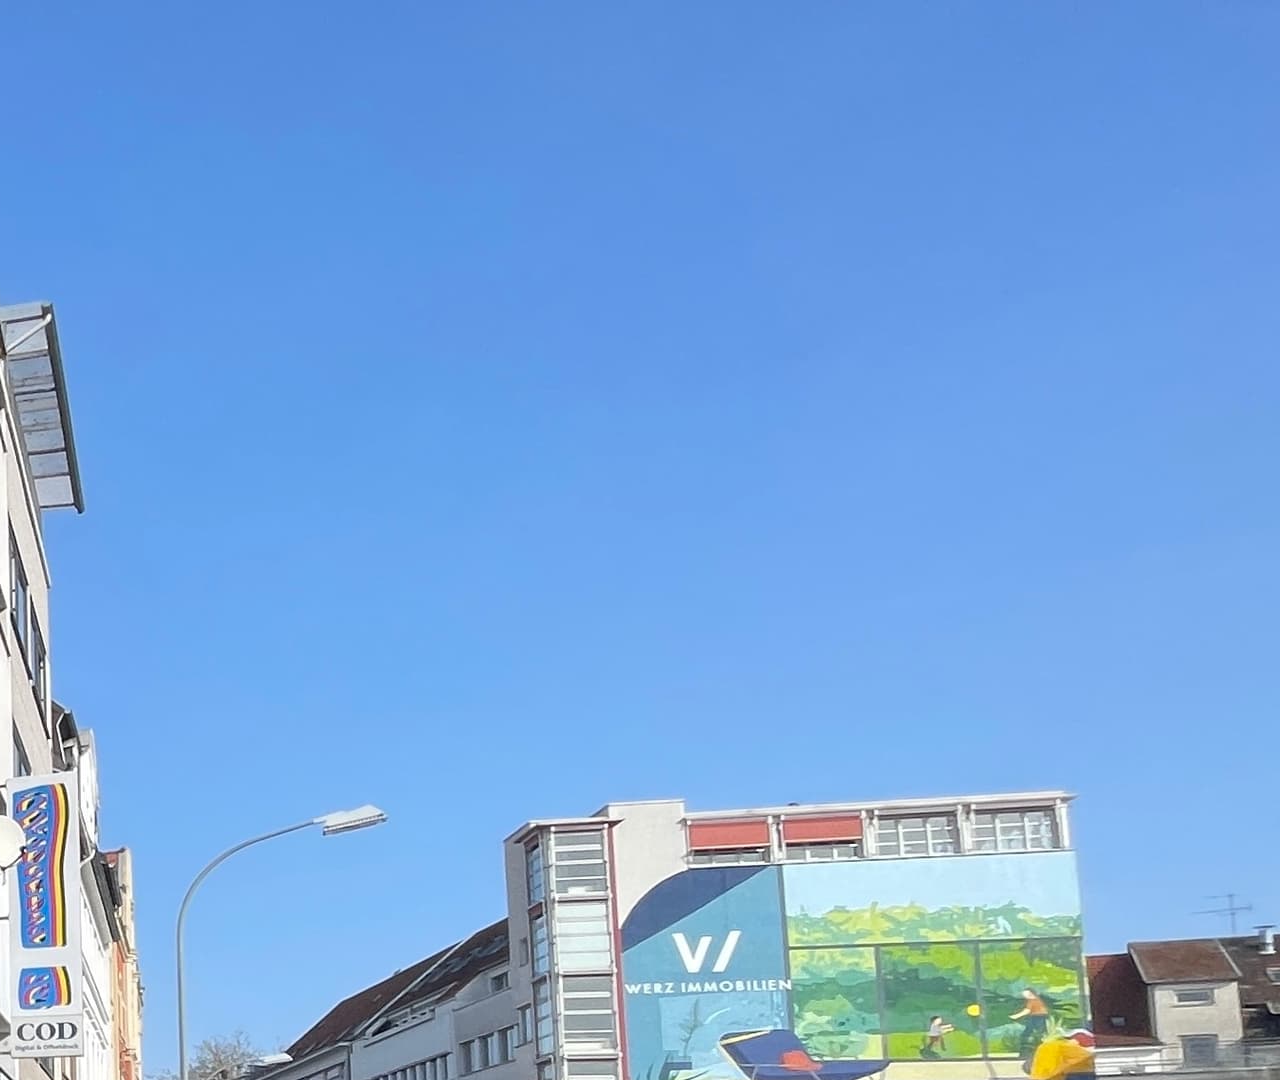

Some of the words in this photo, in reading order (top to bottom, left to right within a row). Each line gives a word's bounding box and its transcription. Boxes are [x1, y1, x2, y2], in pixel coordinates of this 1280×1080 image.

[624, 982, 675, 995] WERZ
[681, 978, 792, 994] IMMOBILIEN
[16, 1021, 78, 1042] COD
